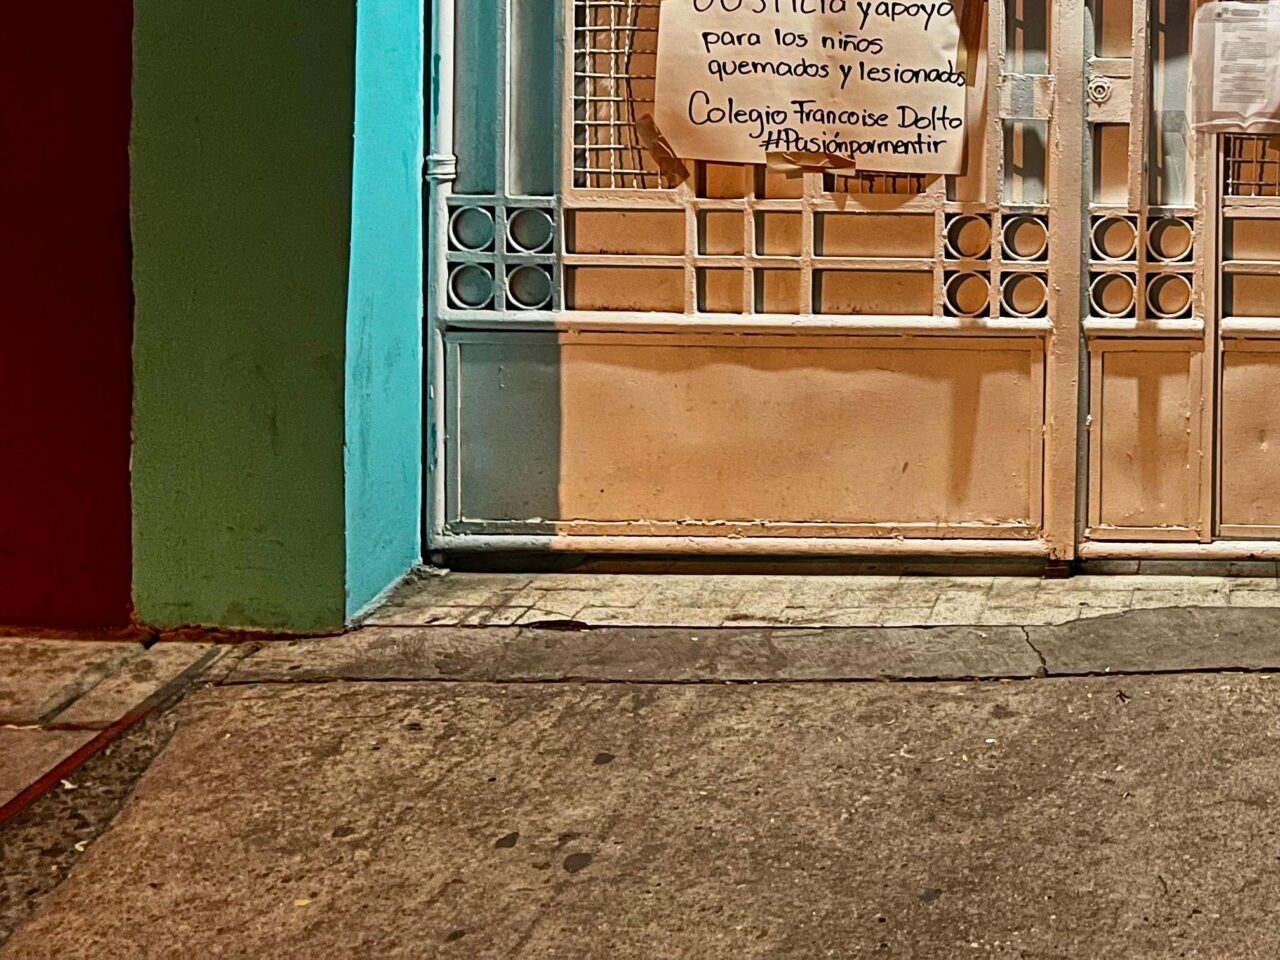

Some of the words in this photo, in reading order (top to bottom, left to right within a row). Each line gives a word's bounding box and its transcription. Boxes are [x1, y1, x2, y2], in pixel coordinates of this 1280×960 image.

[701, 31, 761, 53] para
[775, 28, 808, 47] los
[821, 31, 884, 55] niños
[708, 58, 829, 82] quemados
[839, 63, 852, 89] y
[860, 60, 966, 87] lesionados
[688, 90, 788, 139] Colegio
[790, 100, 889, 127] Francoise
[896, 105, 963, 130] Dolto
